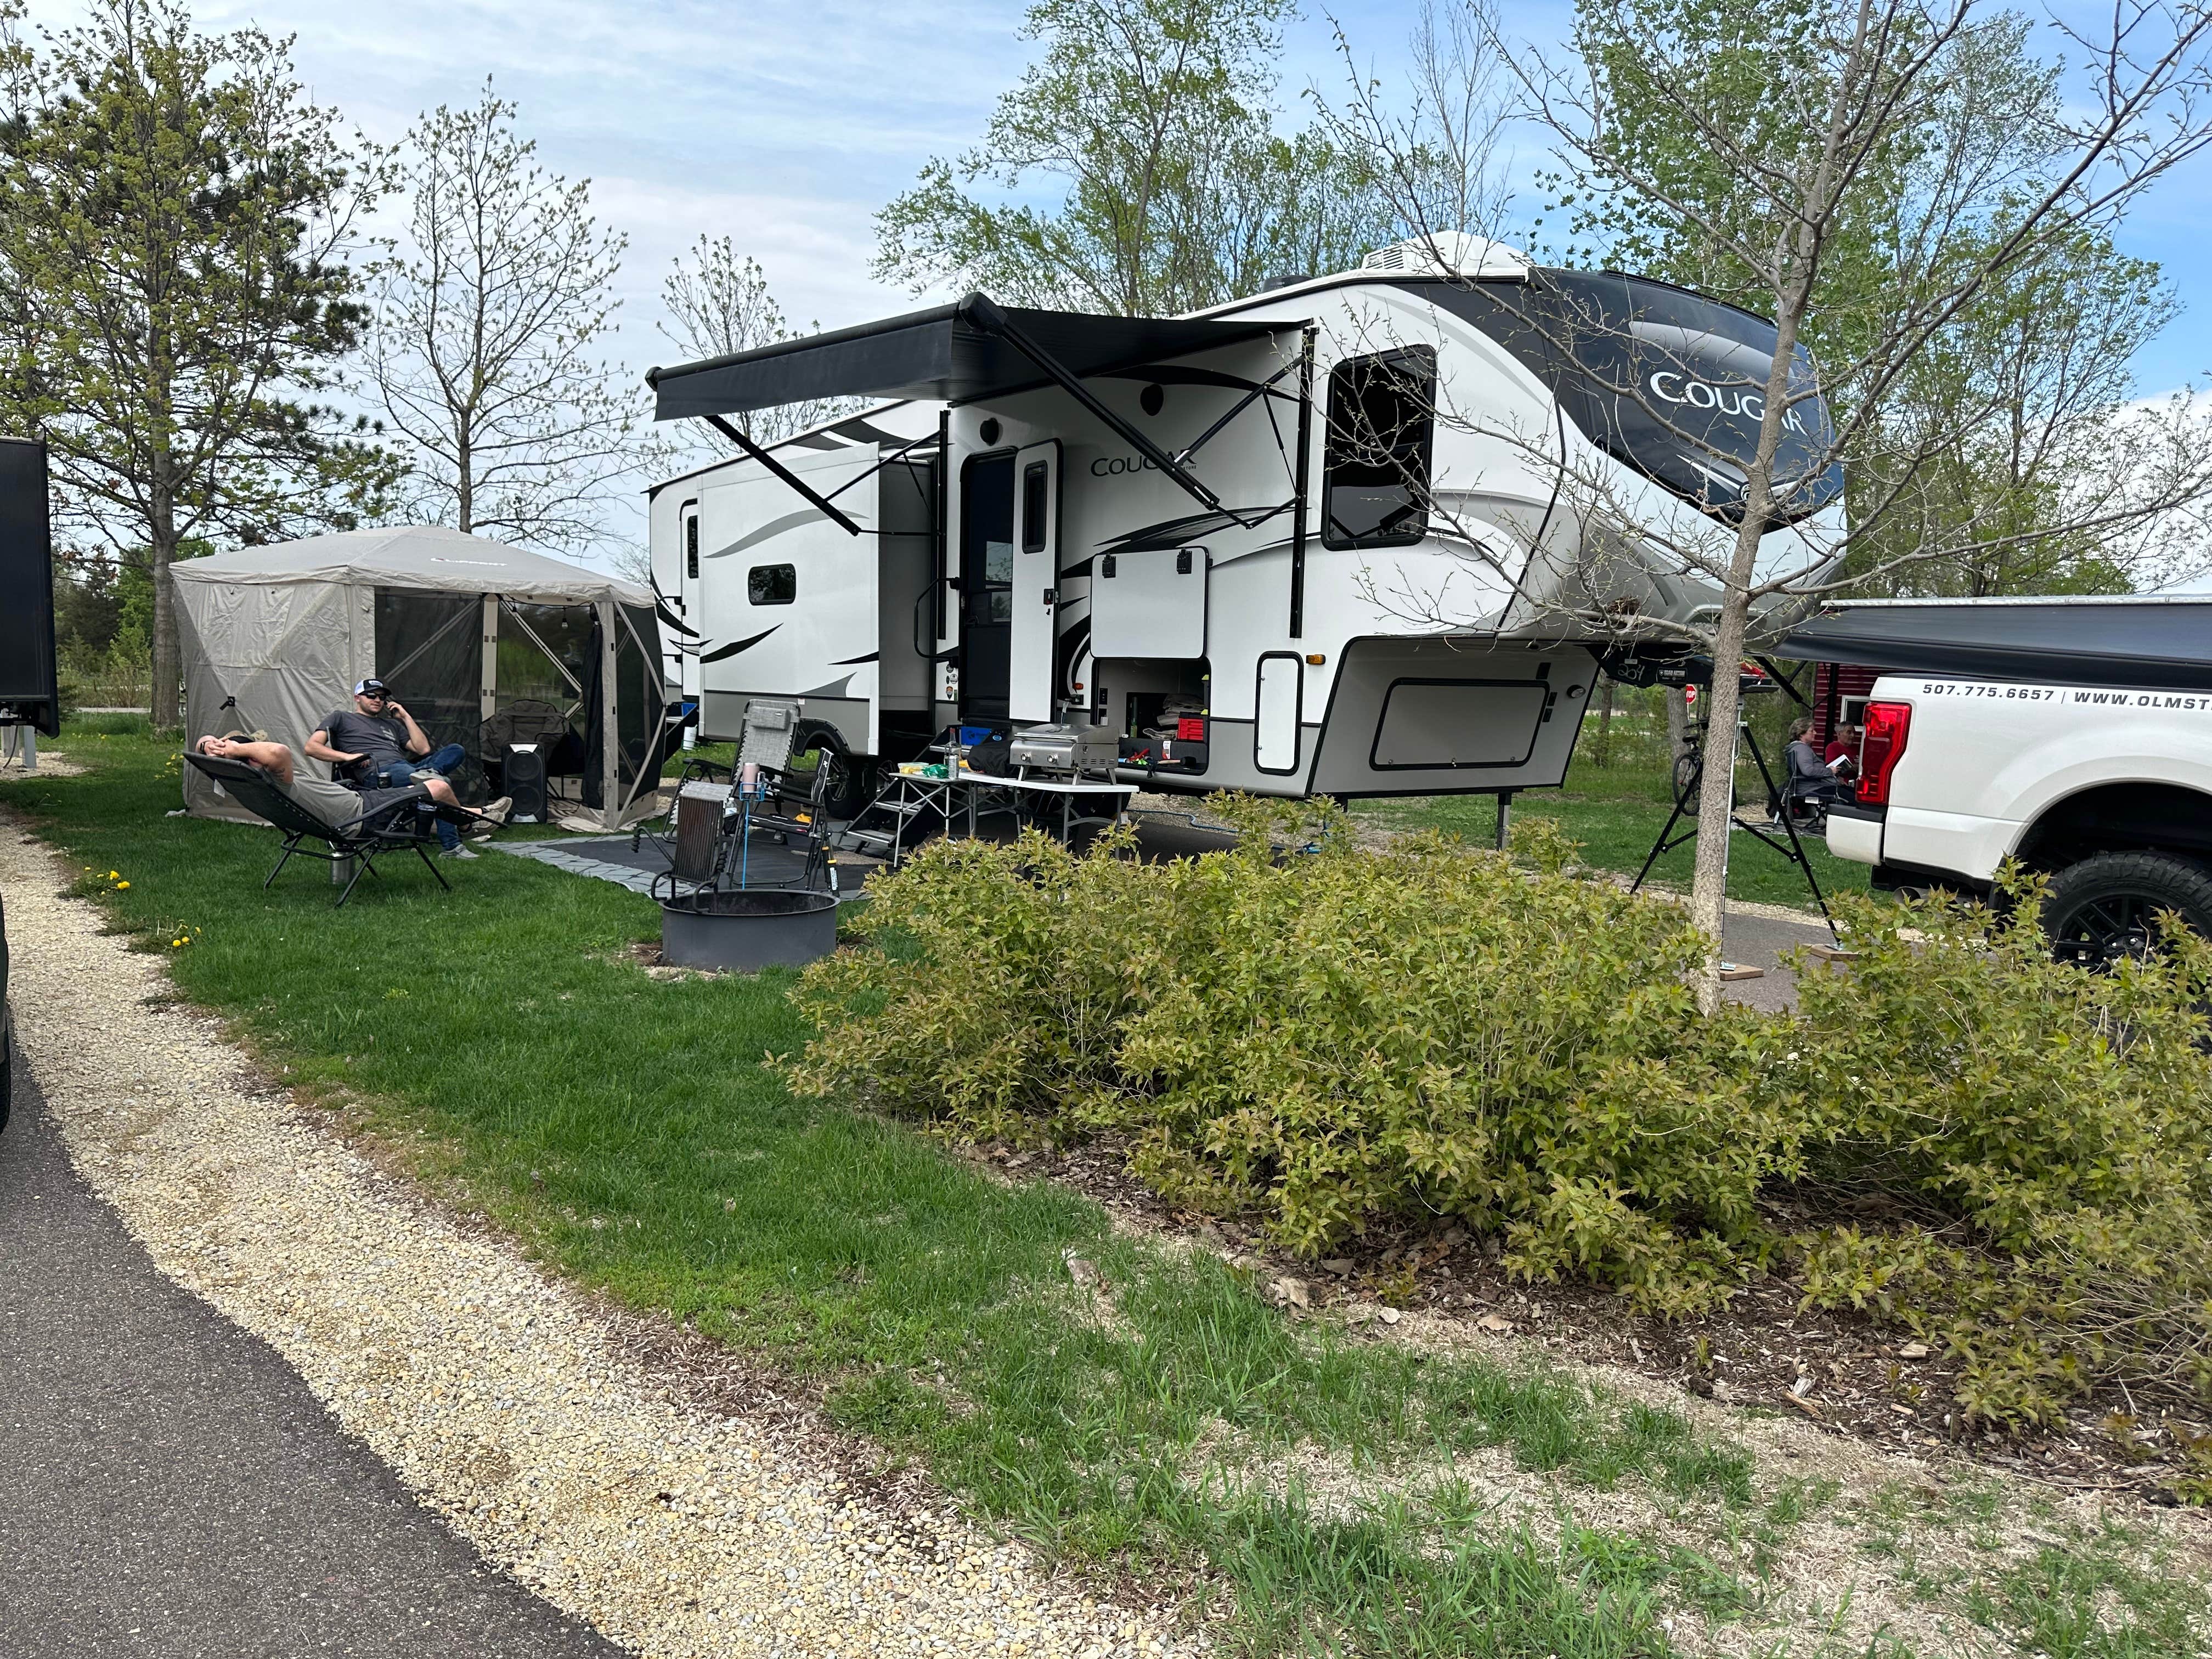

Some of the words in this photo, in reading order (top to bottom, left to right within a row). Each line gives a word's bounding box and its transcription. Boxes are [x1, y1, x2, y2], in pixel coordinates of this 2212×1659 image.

[1618, 663, 1645, 681] 204
[1686, 690, 1695, 698] TOP
[1923, 684, 2054, 701] 507.775.6657
[2074, 692, 2212, 710] WWW.OLMST
